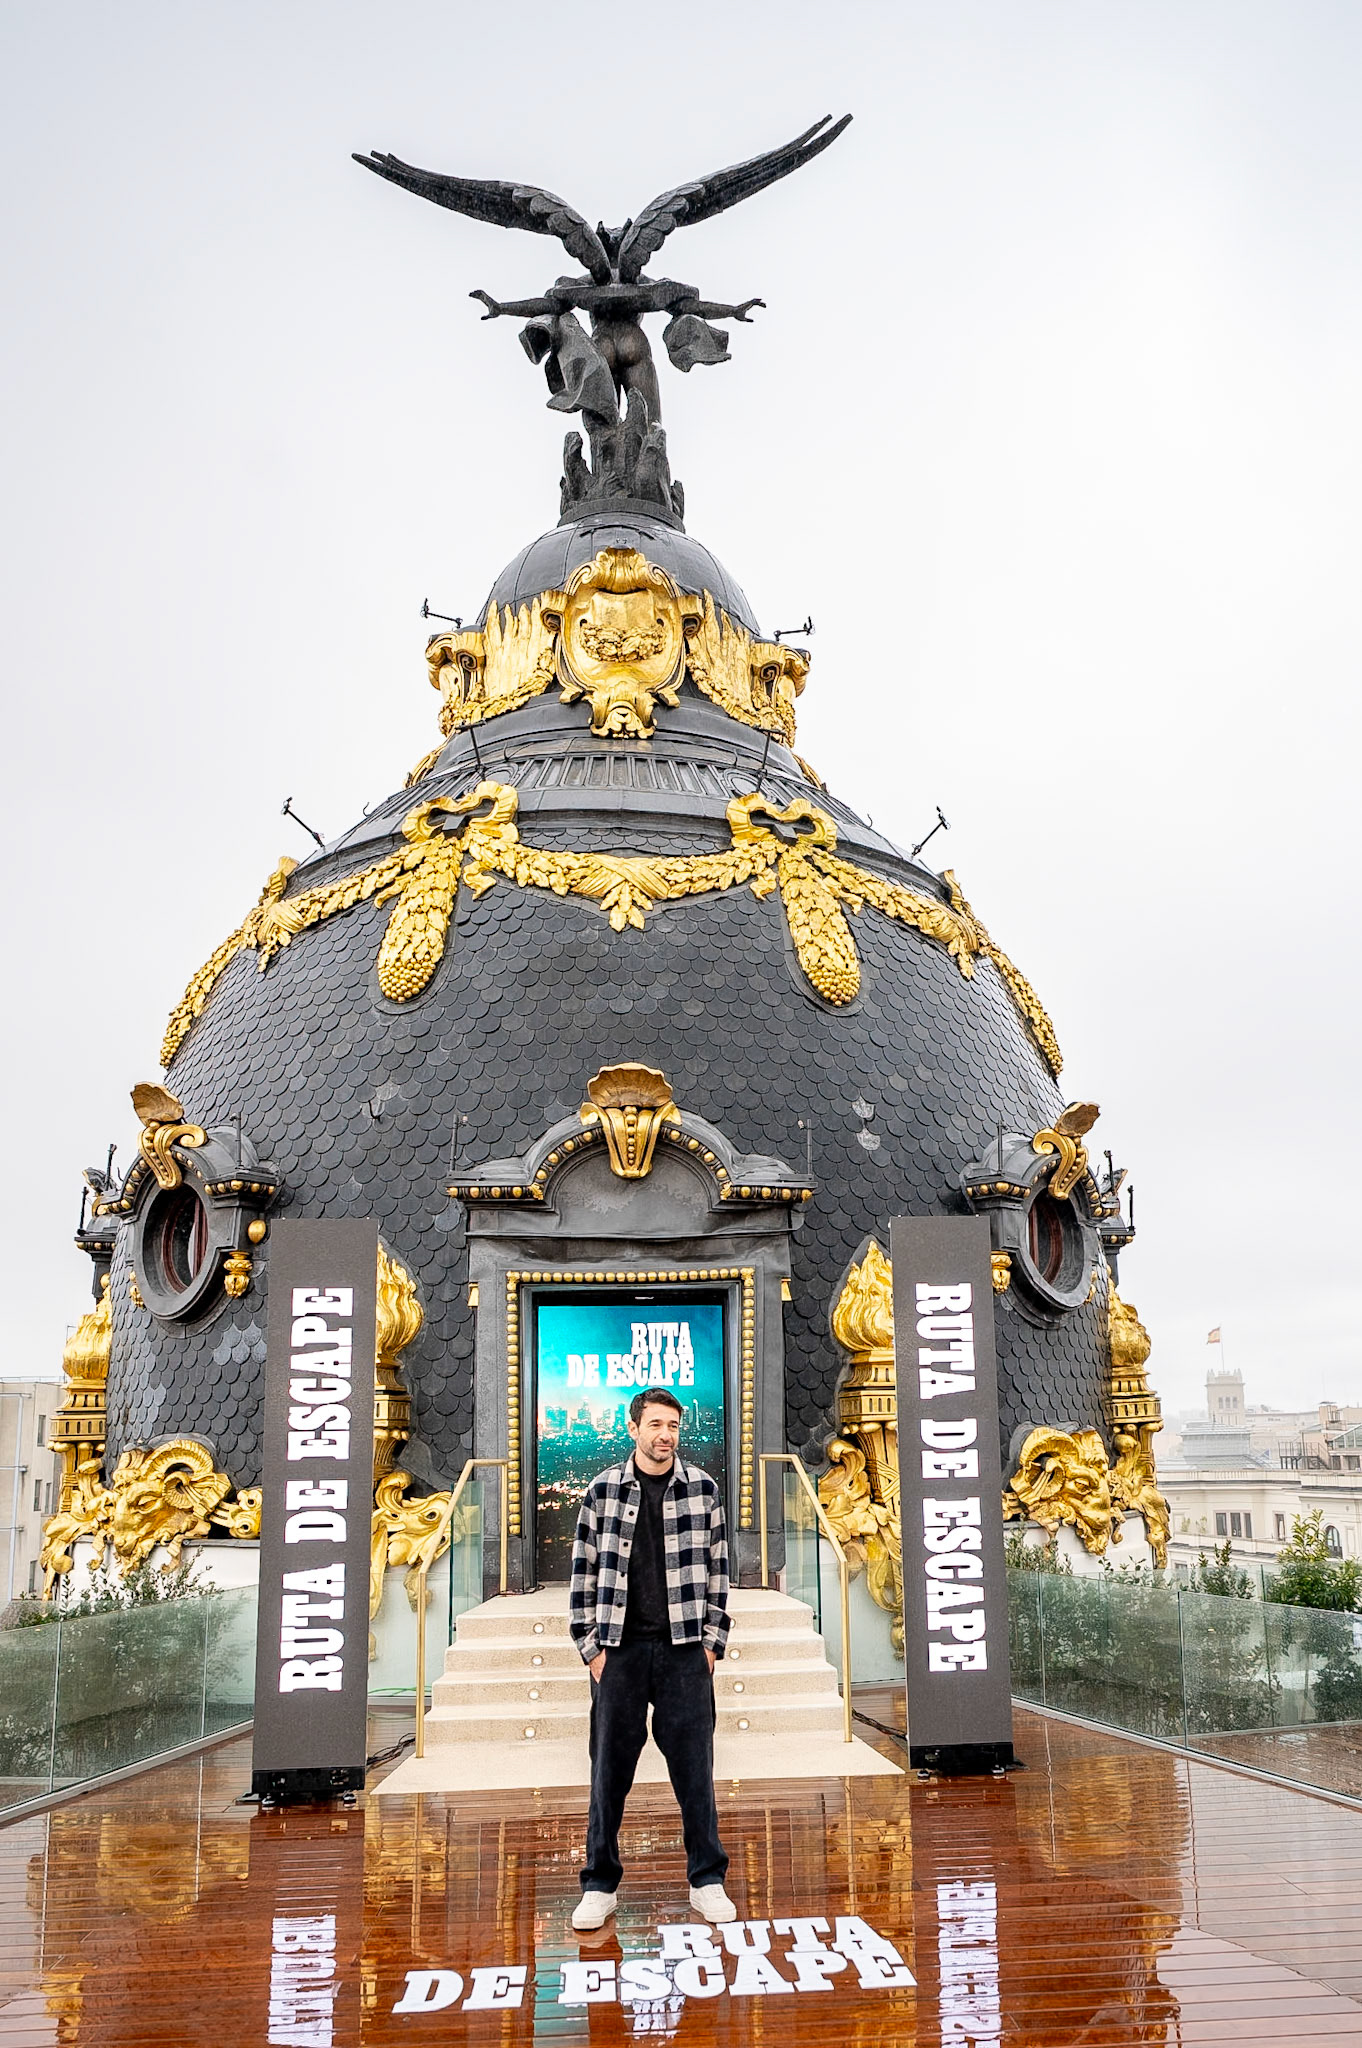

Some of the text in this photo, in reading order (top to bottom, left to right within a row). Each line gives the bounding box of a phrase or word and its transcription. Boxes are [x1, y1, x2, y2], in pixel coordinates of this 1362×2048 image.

[631, 1322, 694, 1356] RUTA
[567, 1354, 695, 1387] DE ESCAPE
[280, 1287, 353, 1693] RUTA DE ESCAPE
[915, 1282, 988, 1672] RUTA DE ESCAPE
[657, 1915, 890, 1959] RUTA
[392, 1946, 918, 2014] DE ESCAPE
